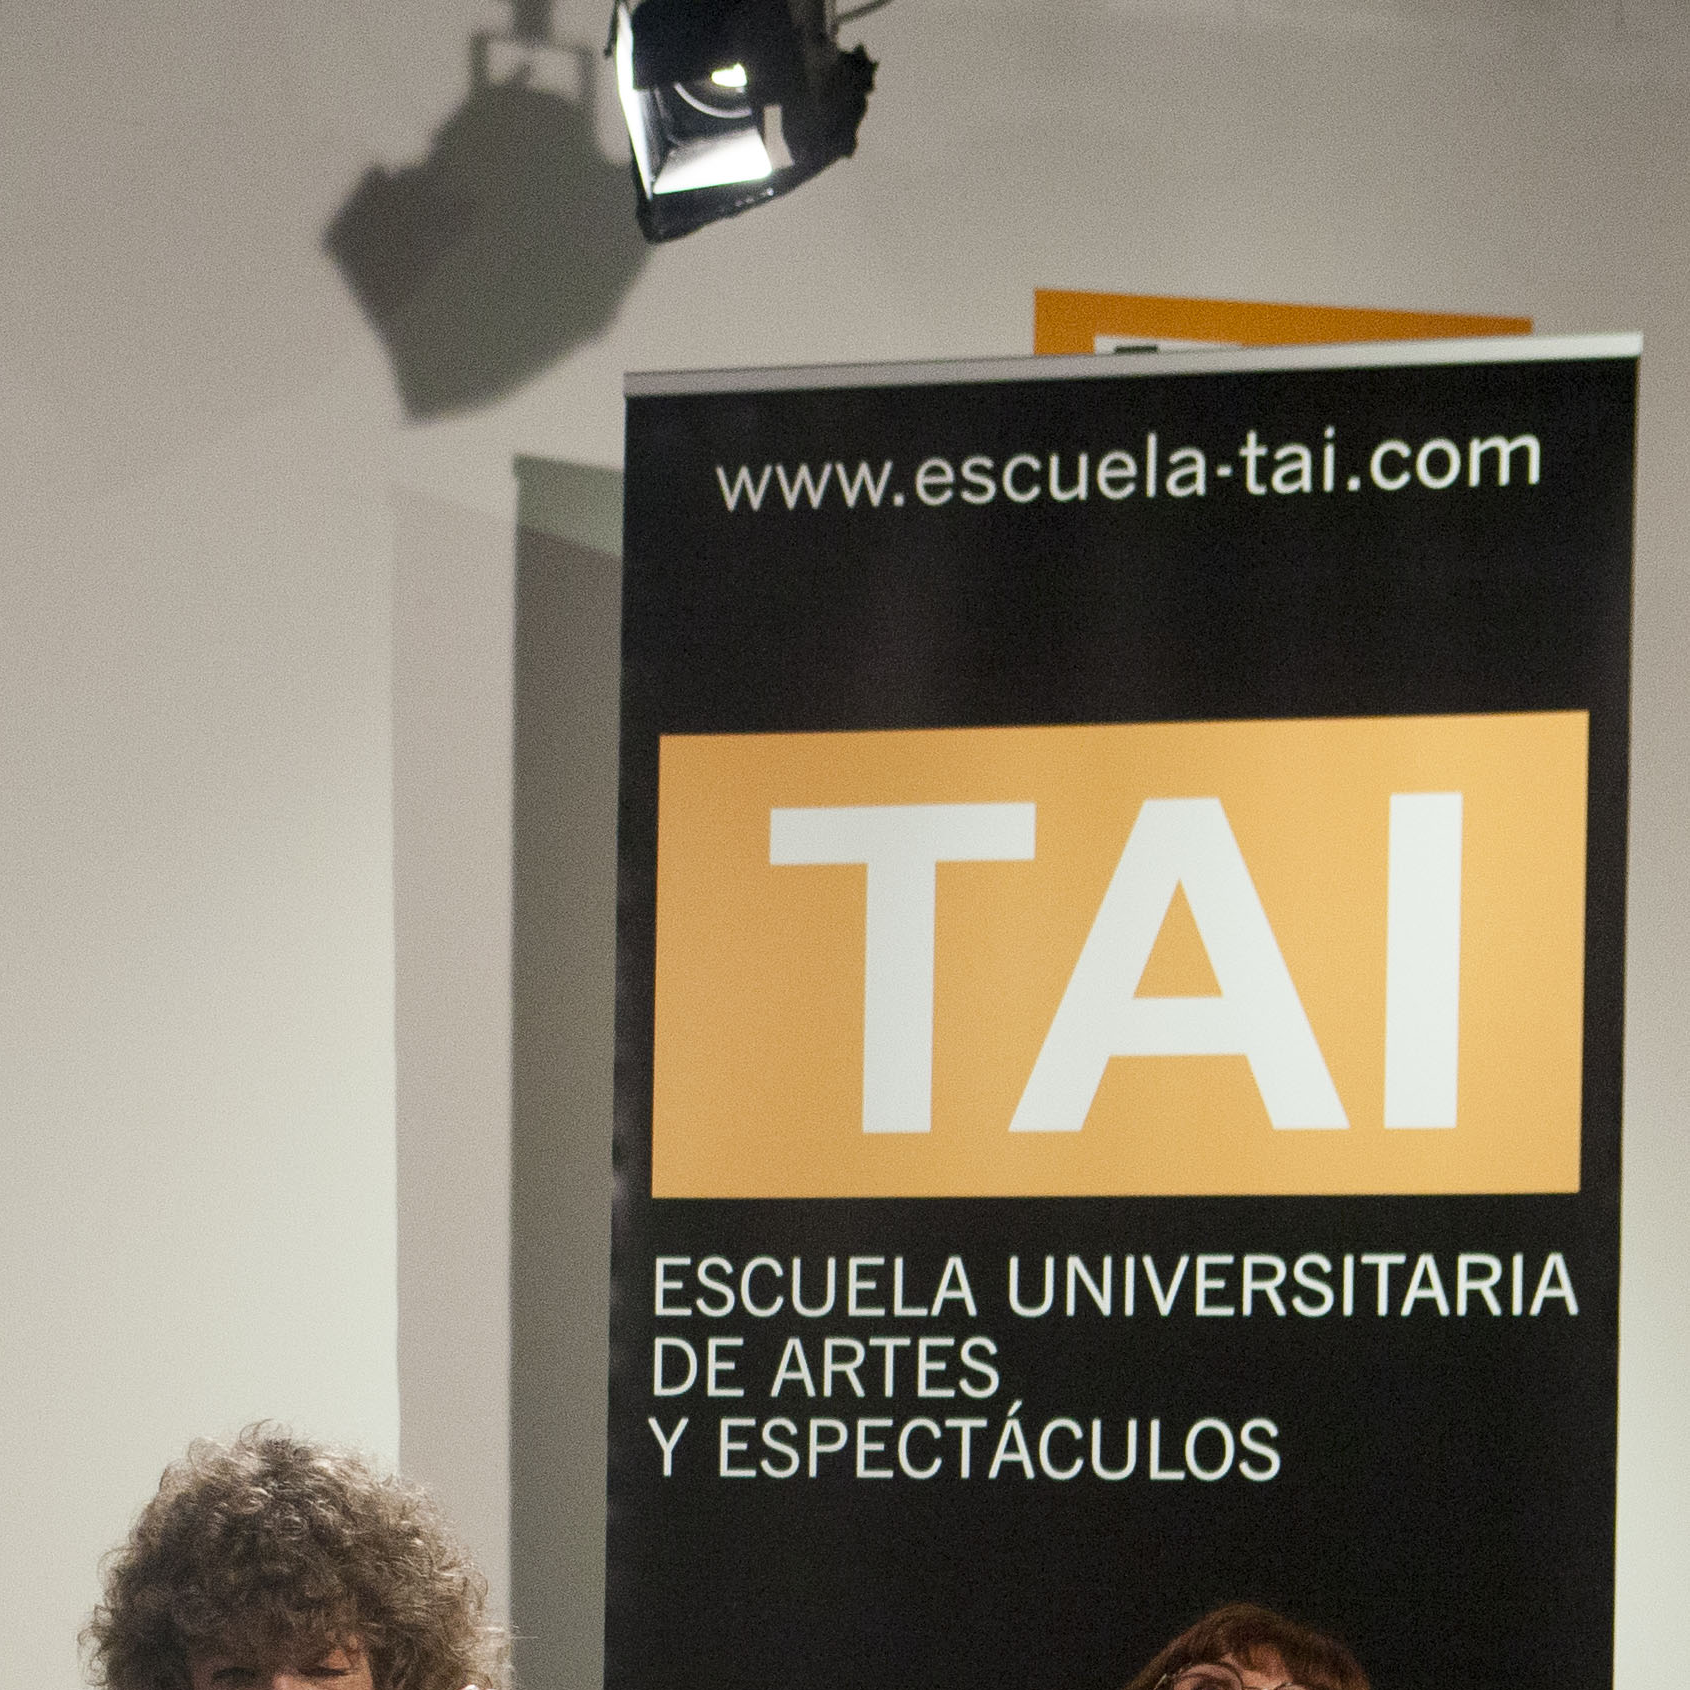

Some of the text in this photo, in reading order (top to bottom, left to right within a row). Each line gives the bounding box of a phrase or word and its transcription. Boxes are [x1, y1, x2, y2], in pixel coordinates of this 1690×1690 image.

[714, 426, 1543, 513] www.escuela-tai.com
[769, 791, 1463, 1134] TAI
[653, 1251, 1580, 1319] ESCUELA UNIVERSITARIA
[652, 1335, 1002, 1400] DE ARTES
[648, 1400, 1282, 1482] Y ESPECTÁCULOS
